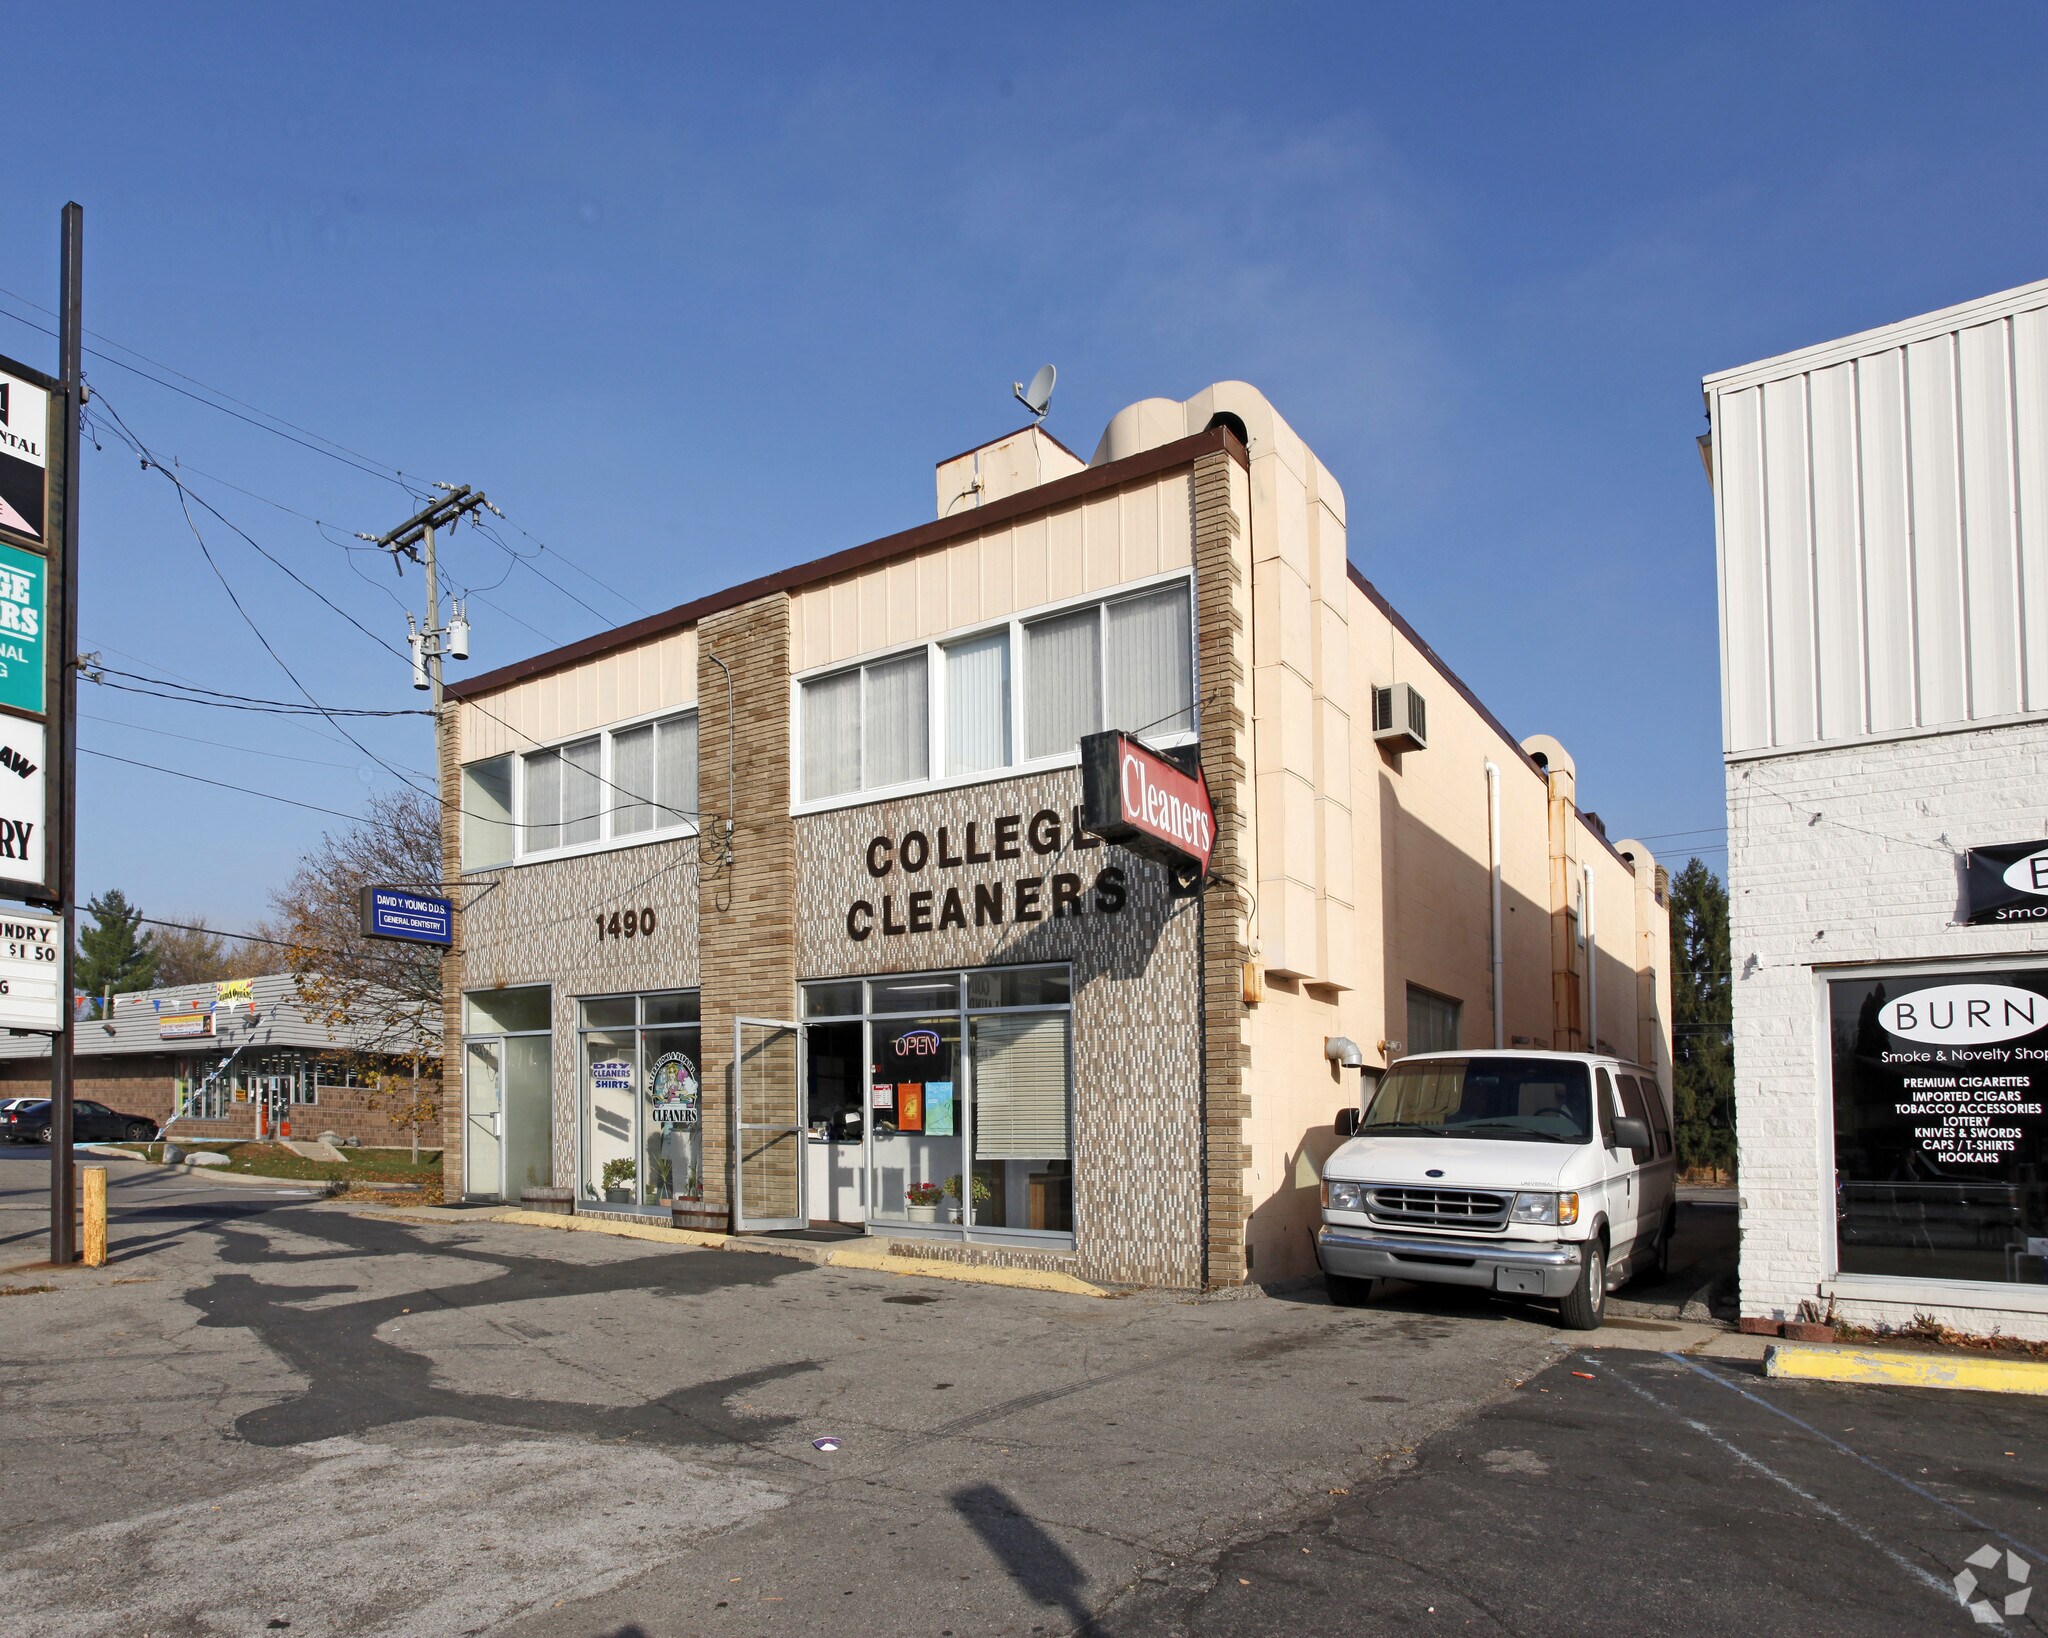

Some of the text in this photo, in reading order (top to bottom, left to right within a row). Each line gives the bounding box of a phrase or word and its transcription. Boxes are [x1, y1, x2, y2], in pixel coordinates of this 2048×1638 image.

[1122, 753, 1210, 852] Cleaners
[377, 895, 447, 915] DAVID Y. YOUNG D.D.S.
[847, 866, 1127, 942] CLEANERS
[383, 914, 441, 931] GENERAL DENTISTRY
[595, 906, 656, 941] 1490
[0, 923, 50, 942] NDRY
[35, 946, 56, 962] 50
[1896, 997, 2035, 1031] BURN
[895, 1036, 937, 1056] OPEN
[1881, 1050, 1931, 1063] Smoke
[1936, 1050, 1947, 1062] &
[1952, 1048, 2011, 1063] Novelty
[593, 1070, 630, 1078] CLEANERS
[648, 1052, 671, 1092] ALTERATIONS
[595, 1079, 629, 1089] SHIRTS
[1903, 1076, 2030, 1088] PREMIUM CIGARETTES
[1912, 1091, 2021, 1102] IMPORTED CIGARS
[652, 1109, 697, 1122] CLEANERS
[1895, 1103, 2042, 1114] TOBACCO ACCESSORIES
[1943, 1116, 1990, 1127] LOTTERY
[1915, 1128, 2022, 1138] KNIVES & SWORDS
[1922, 1140, 2015, 1151] CAPS / T-SHIRTS
[1938, 1152, 1999, 1163] HOOKAHS
